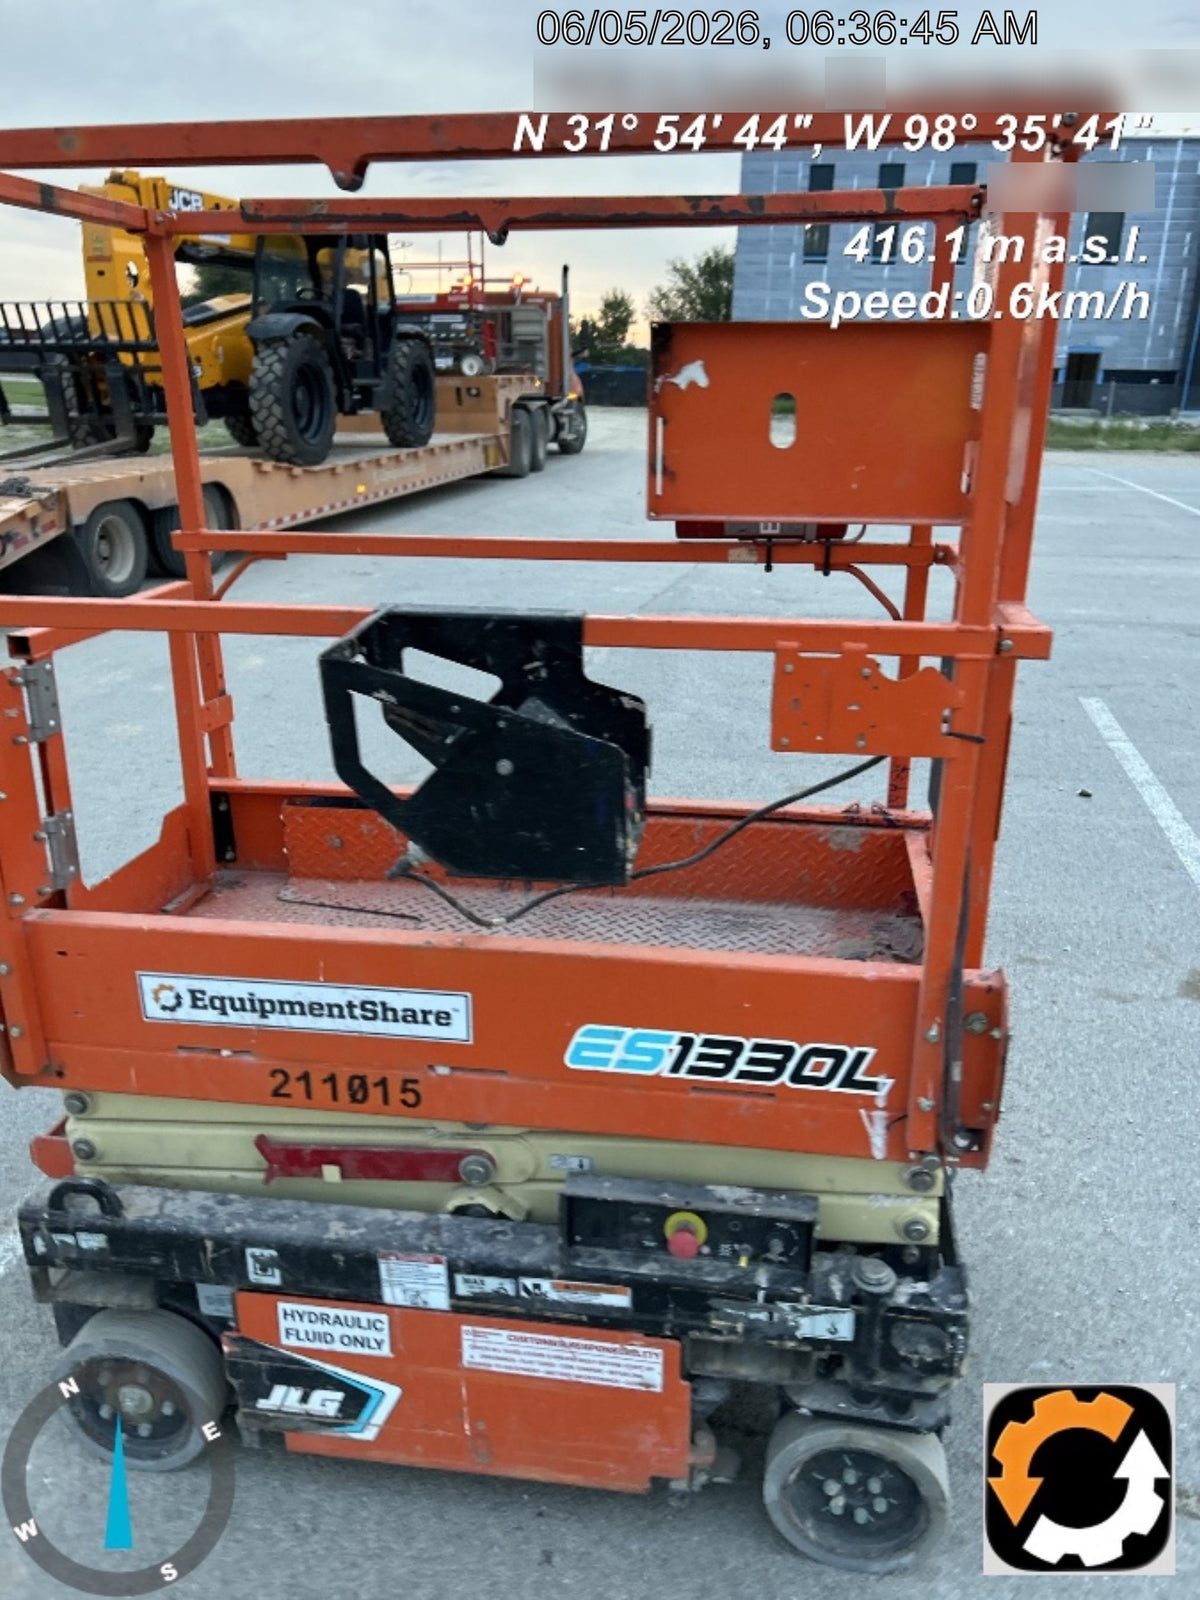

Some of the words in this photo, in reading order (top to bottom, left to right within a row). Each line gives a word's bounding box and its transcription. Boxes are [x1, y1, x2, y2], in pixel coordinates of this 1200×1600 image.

[169, 188, 204, 211] JCB
[187, 988, 453, 1028] EquipmentShare
[564, 1024, 894, 1095] ES1330L
[269, 1069, 422, 1109] 211015
[282, 1308, 385, 1332] HYDRAULIC
[285, 1327, 335, 1345] FLUID
[340, 1334, 385, 1351] ONLY
[256, 1384, 346, 1417] JLG
